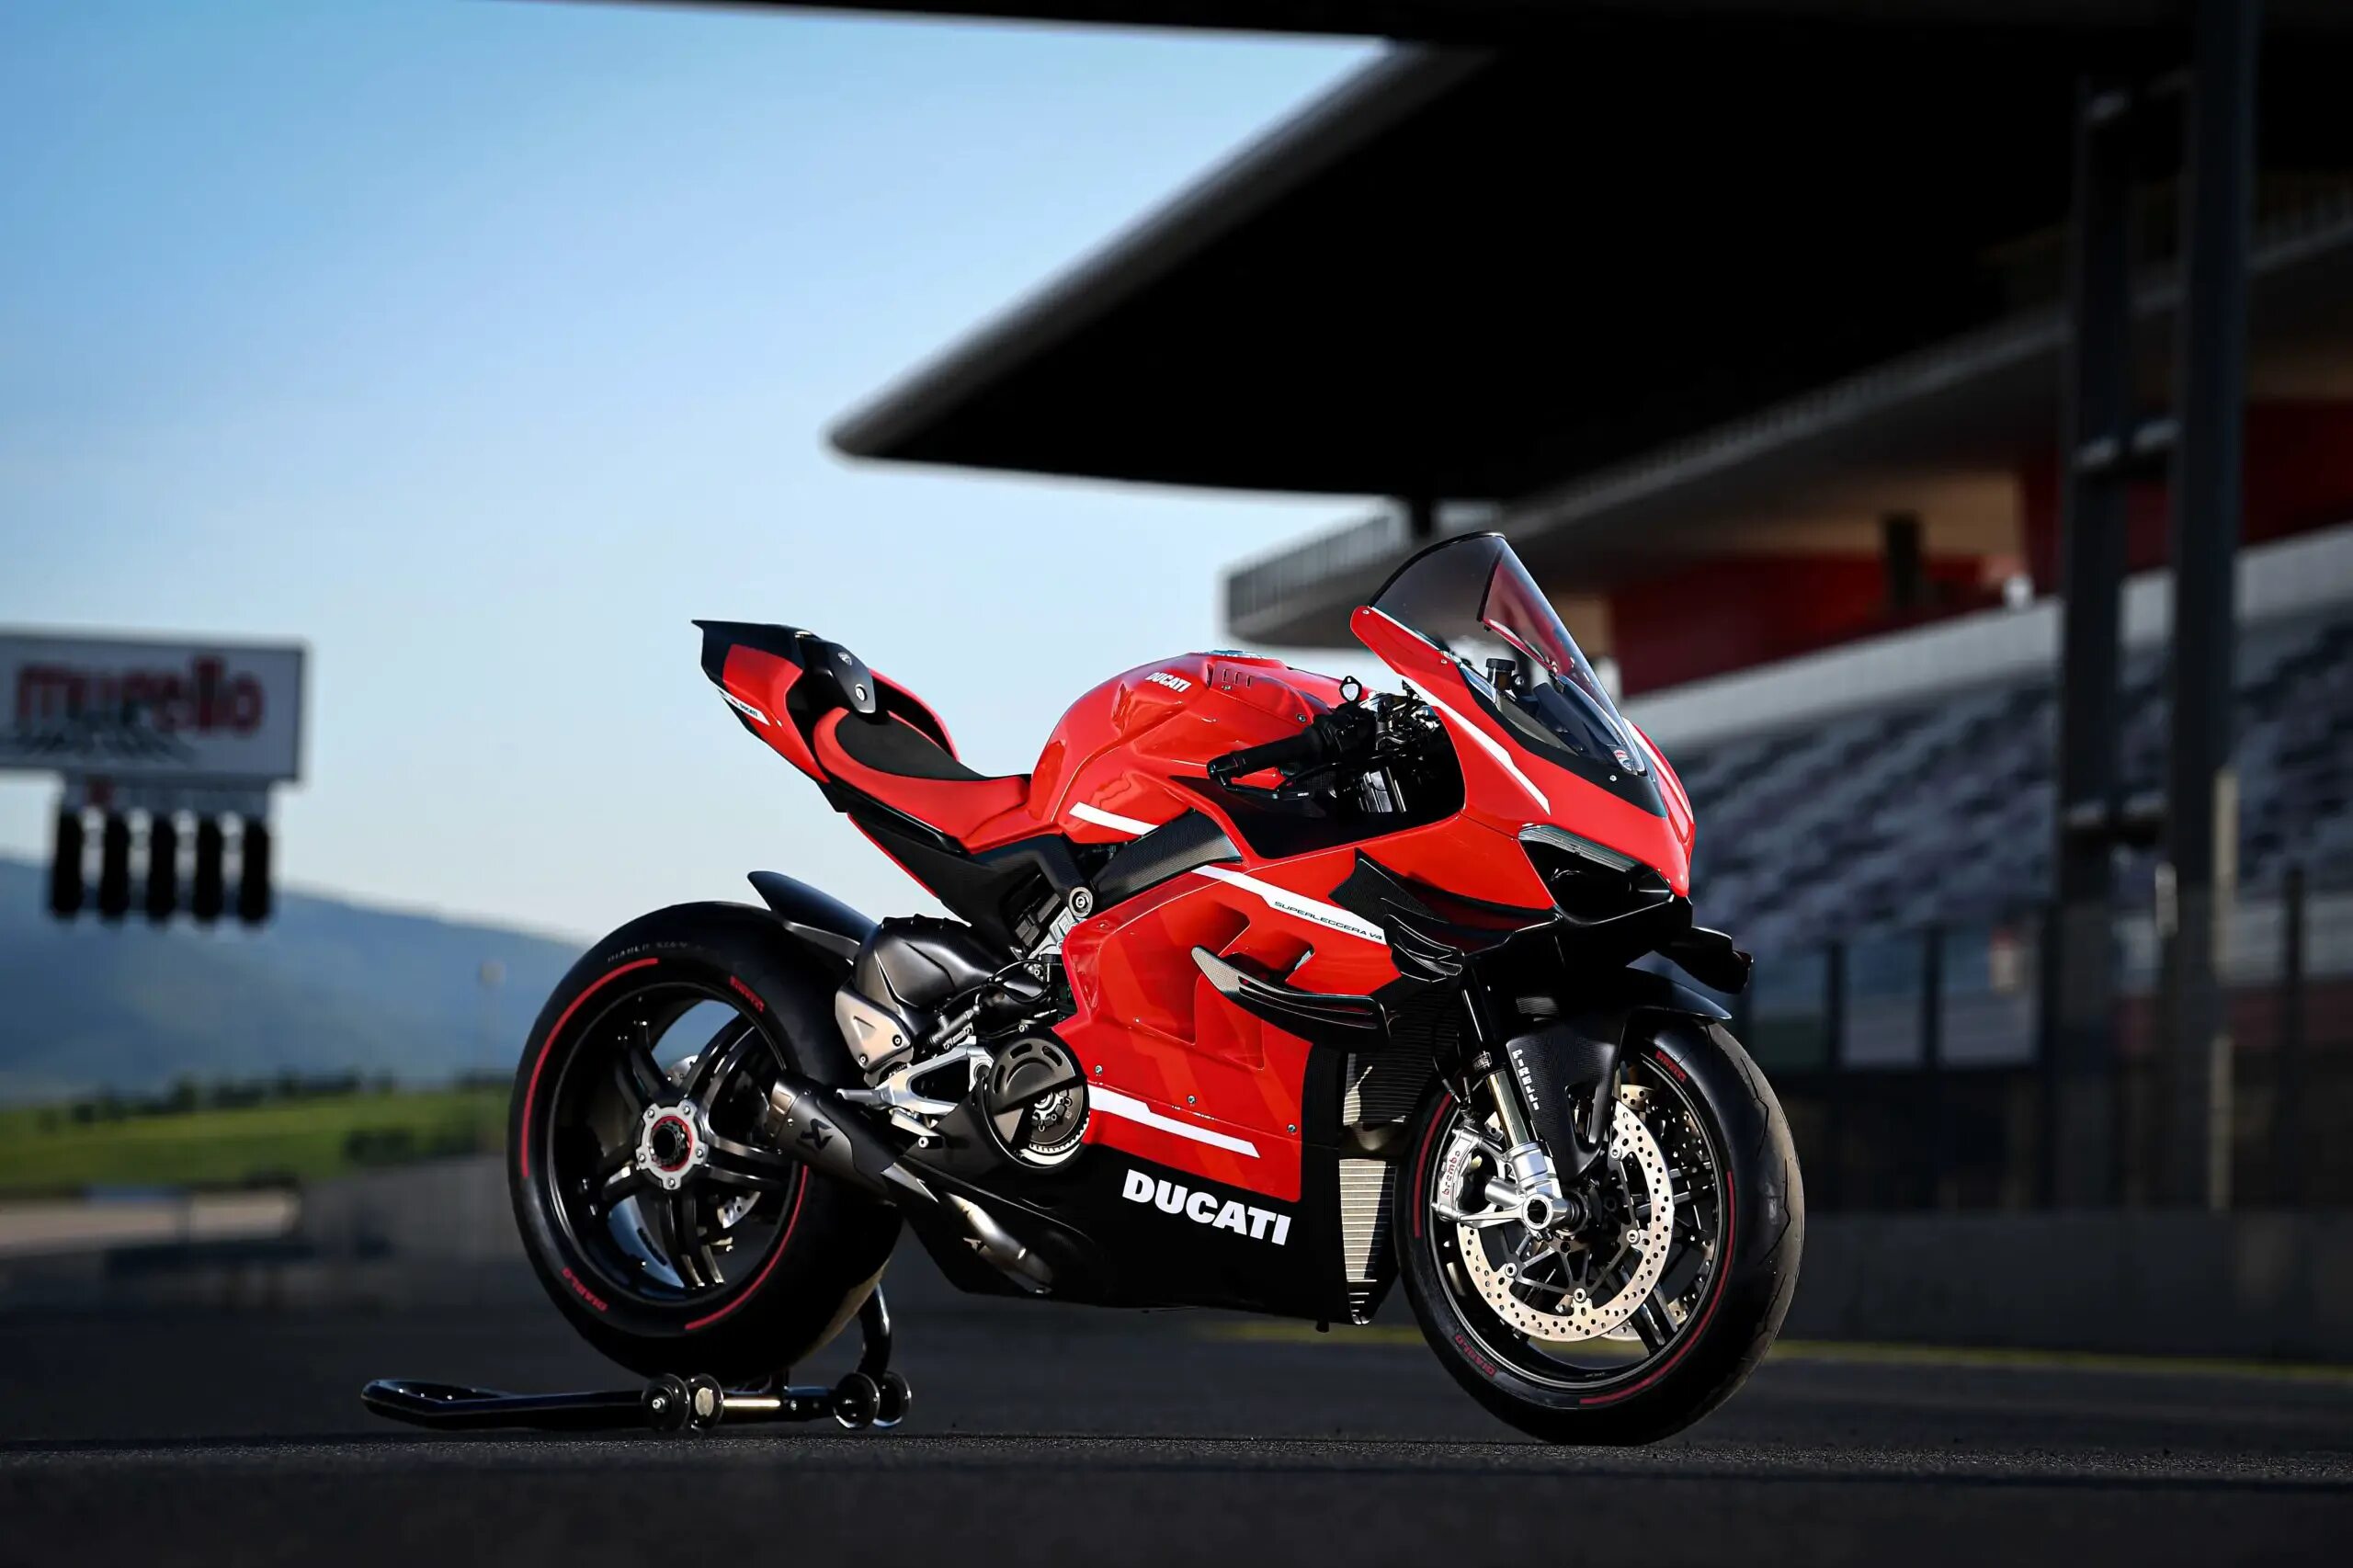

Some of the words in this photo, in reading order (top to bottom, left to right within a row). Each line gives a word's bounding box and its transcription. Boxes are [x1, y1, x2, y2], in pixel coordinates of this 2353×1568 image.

[1144, 672, 1192, 693] DUCATI
[1274, 901, 1367, 936] SUPERLEGGERA
[1370, 931, 1383, 940] V4
[1512, 1049, 1540, 1111] PIRELLI
[1442, 1150, 1461, 1196] brembo
[1122, 1168, 1291, 1245] DUCATI
